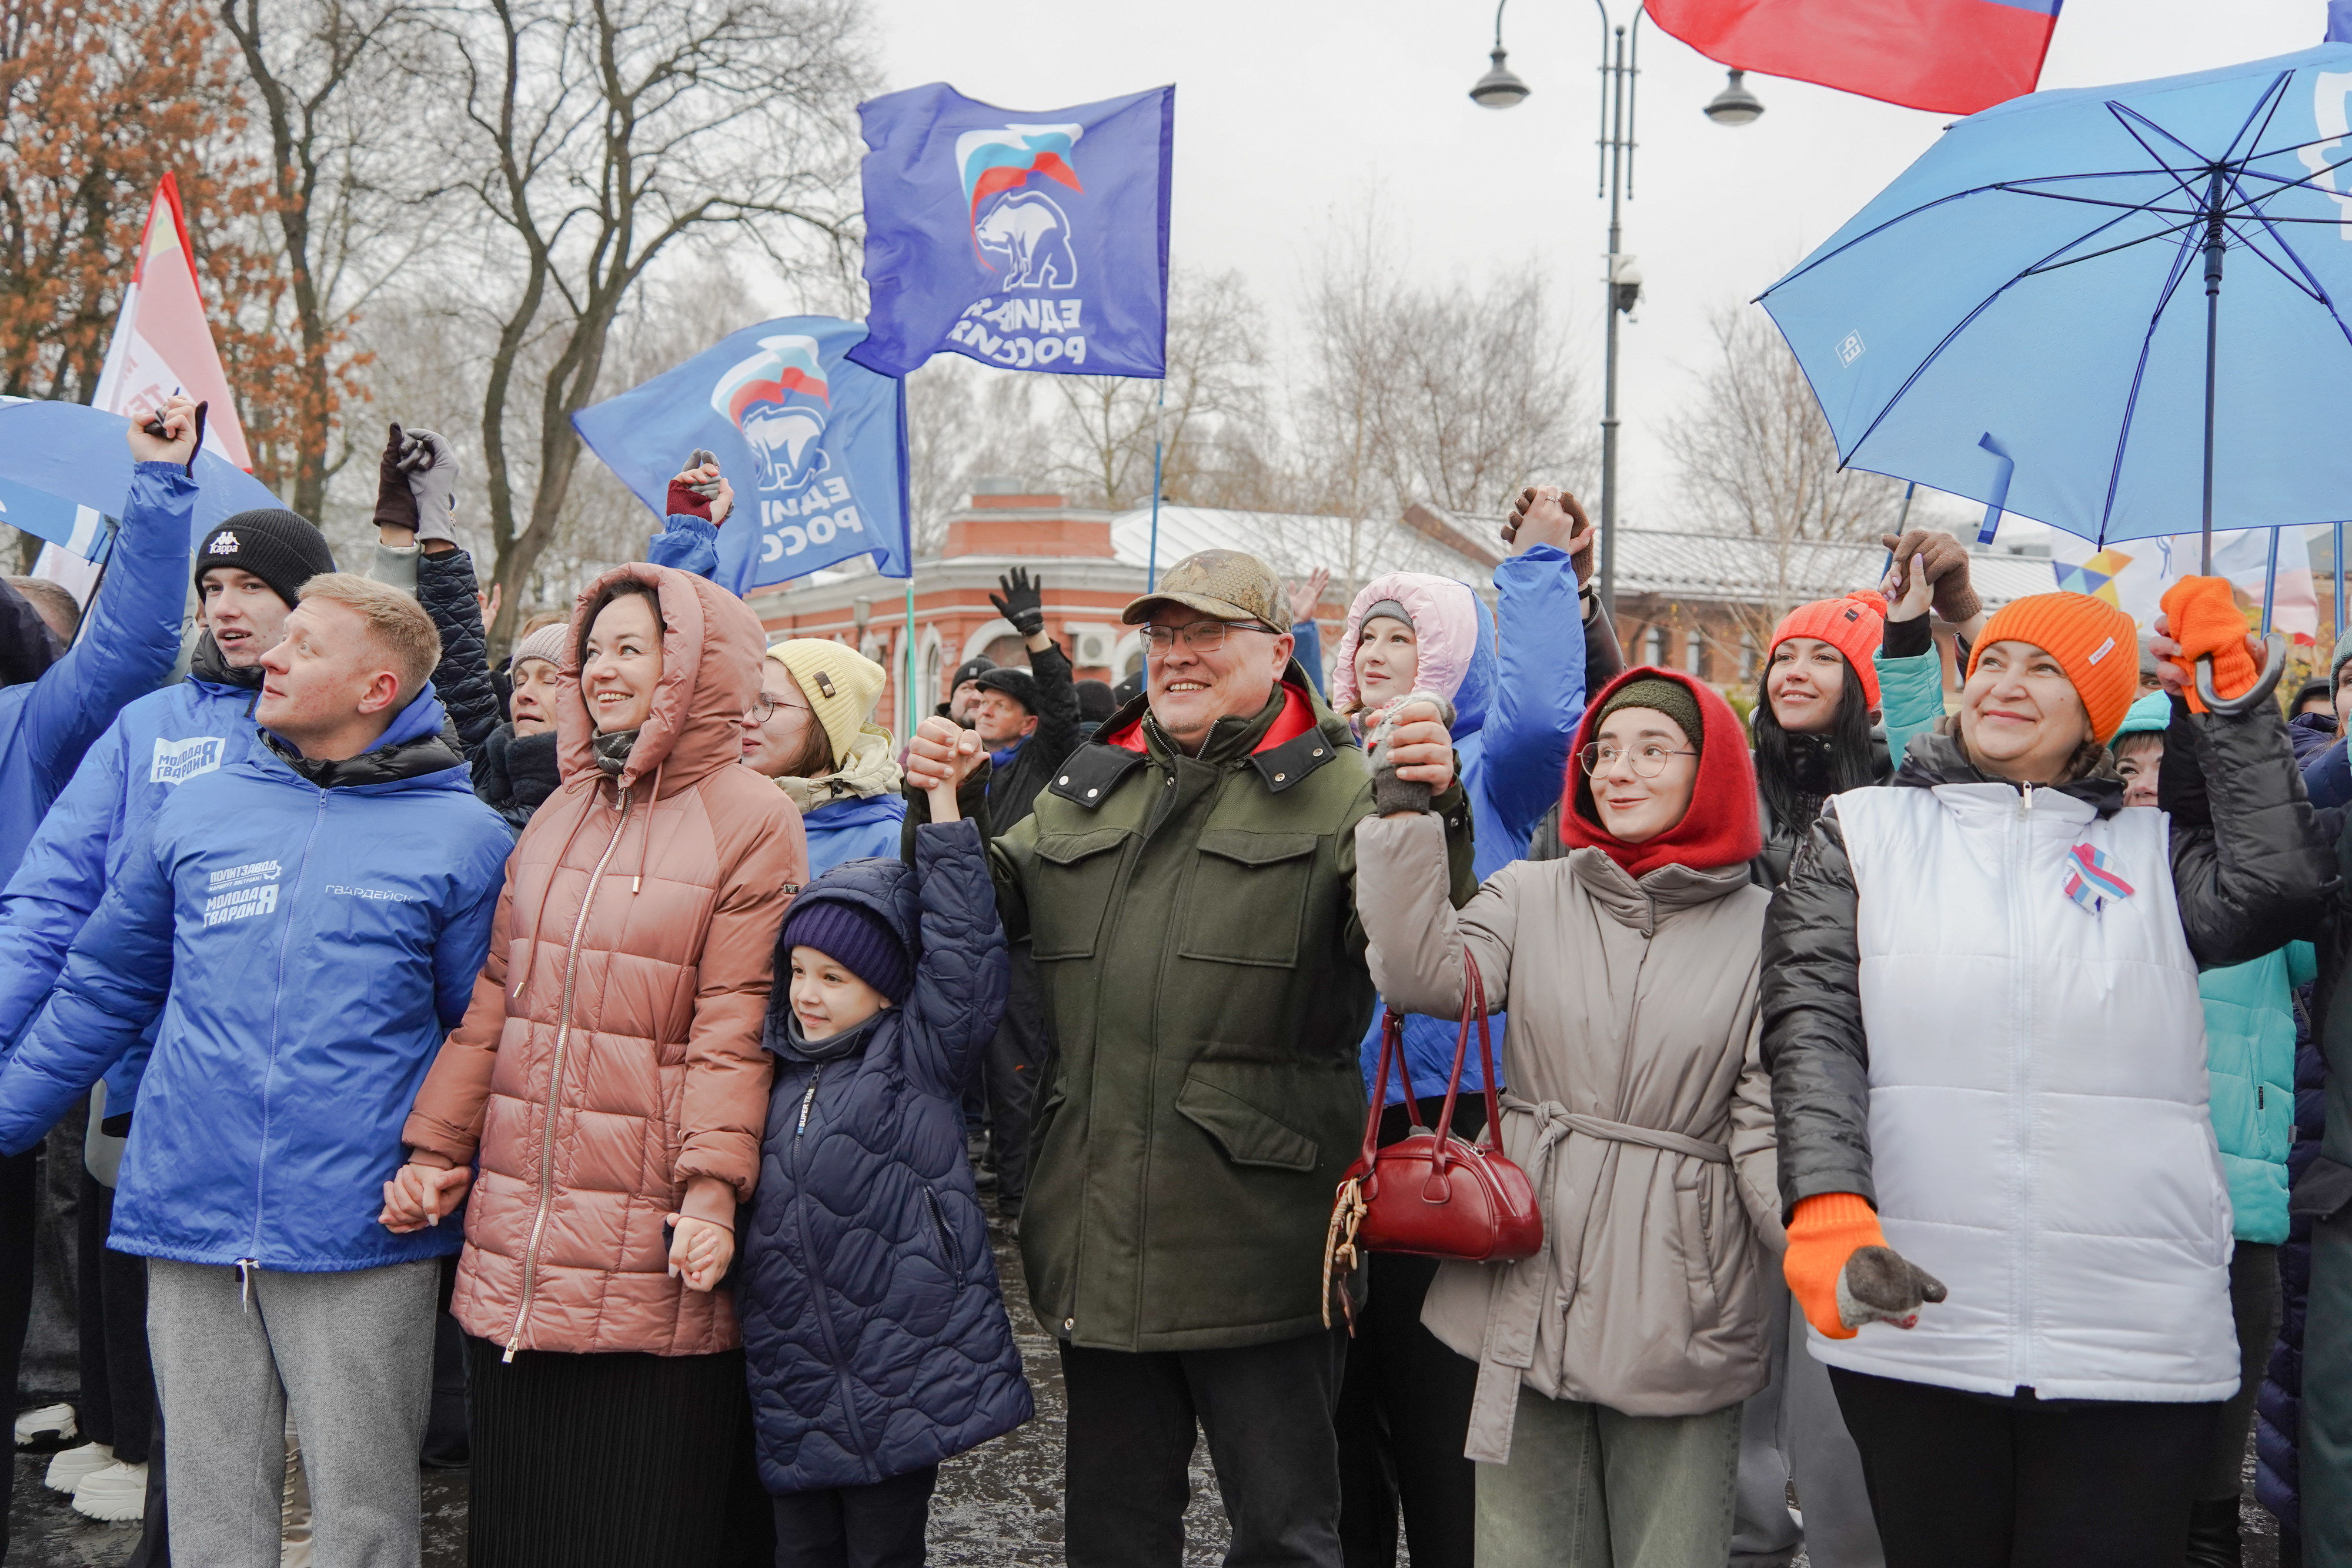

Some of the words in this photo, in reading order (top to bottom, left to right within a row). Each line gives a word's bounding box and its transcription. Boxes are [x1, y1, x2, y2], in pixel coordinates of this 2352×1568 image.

[209, 544, 239, 554] Kappa
[210, 860, 278, 883] ПОЛИТЗАВОД
[208, 881, 233, 892] МАРШРУТ
[325, 884, 413, 904] ГВАРДЕЙСК
[803, 1088, 815, 1104] TEAM
[799, 1104, 809, 1128] SUPER
